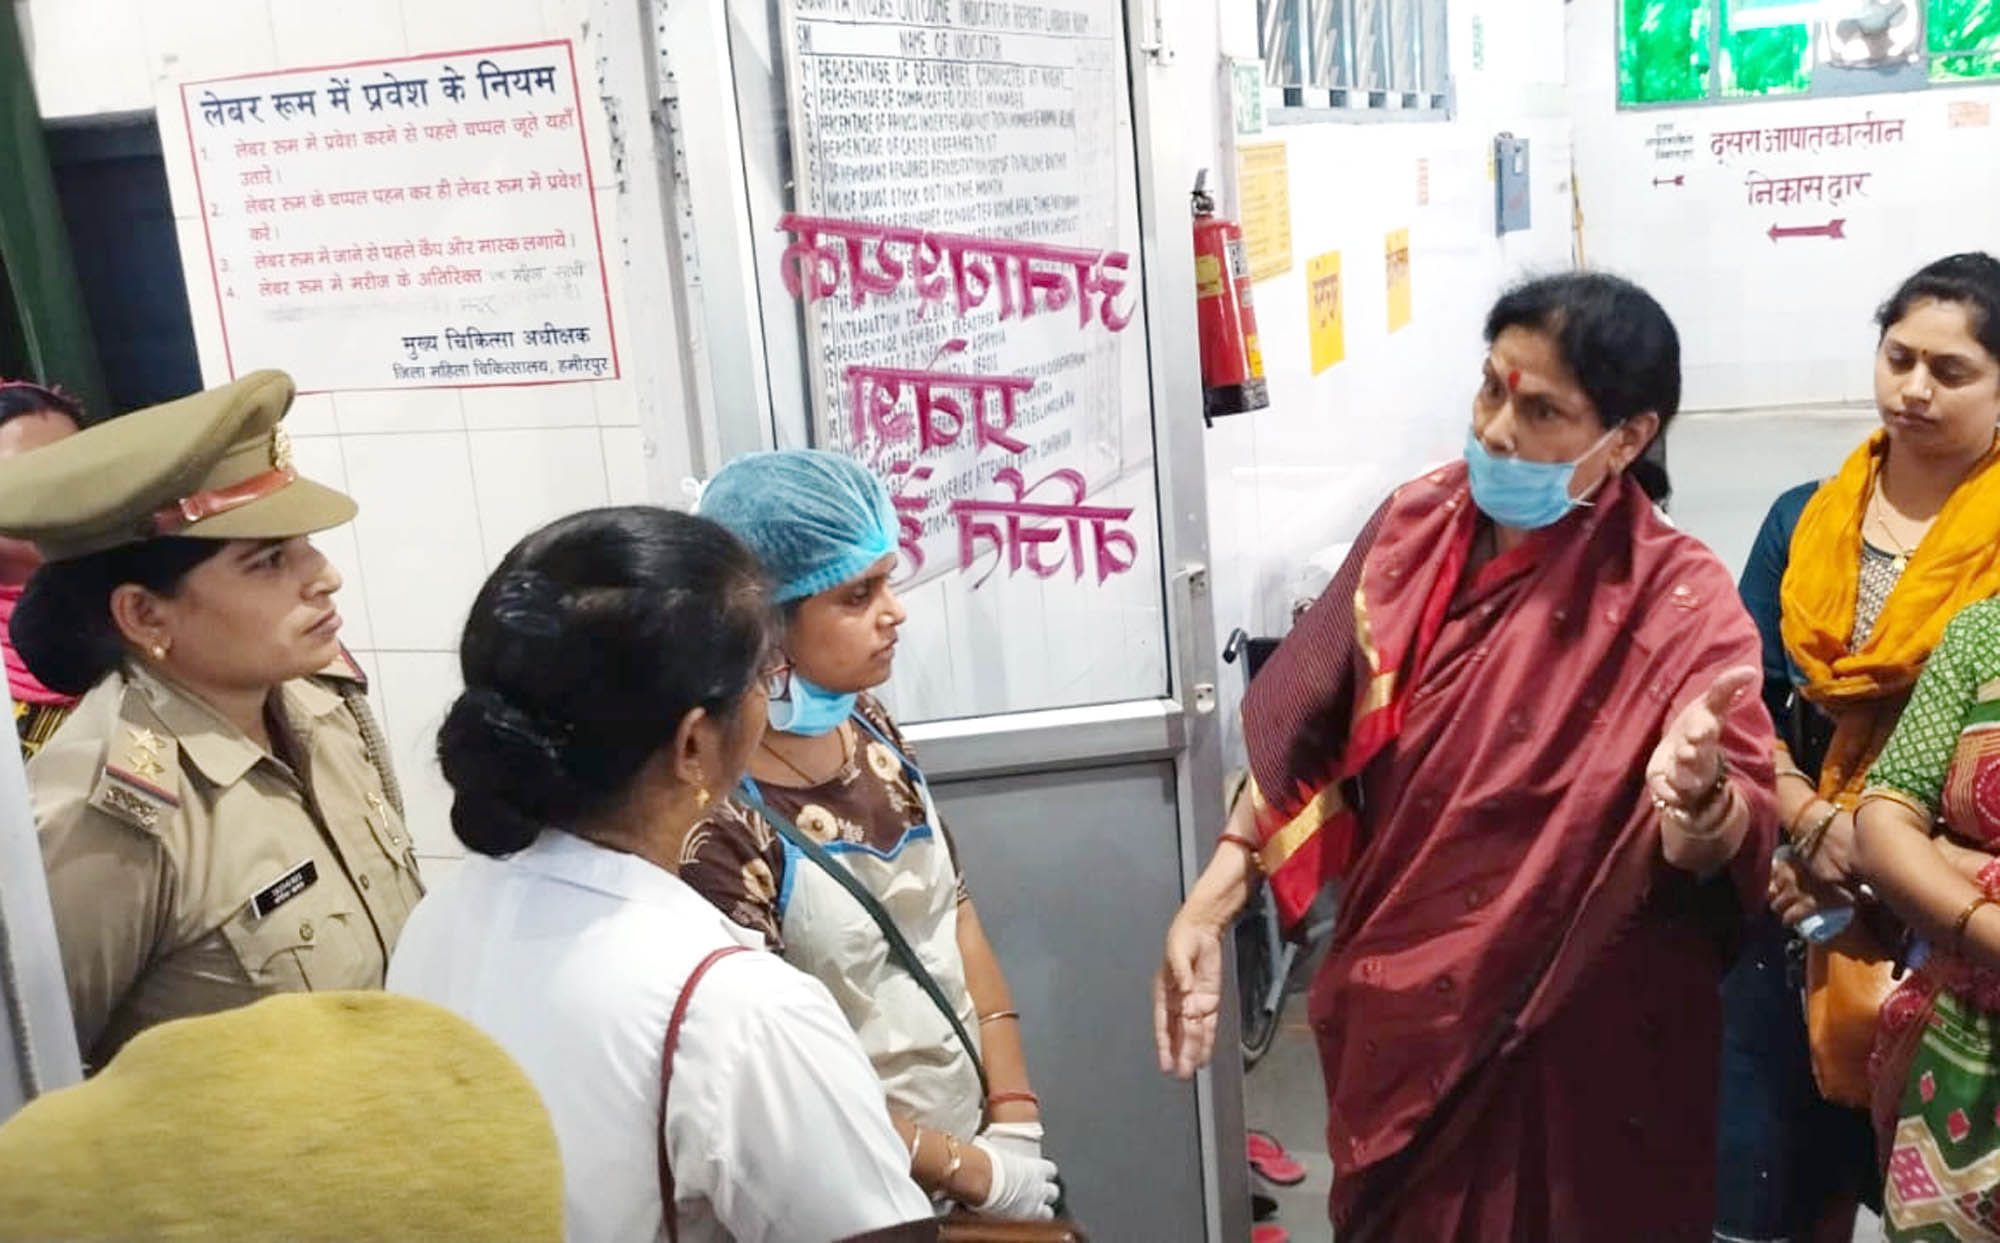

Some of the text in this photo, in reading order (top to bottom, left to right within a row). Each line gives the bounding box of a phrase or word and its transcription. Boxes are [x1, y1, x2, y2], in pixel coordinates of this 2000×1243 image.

[200, 60, 557, 127] लेबर रूम में प्रवेश के नियम
[234, 138, 267, 158] लेबर
[272, 138, 299, 155] रूम
[323, 128, 358, 150] प्रवेश
[363, 123, 398, 145] करने
[403, 121, 418, 143] से
[423, 117, 458, 142] पहले
[463, 117, 506, 138] चप्पल
[511, 111, 539, 139] जूते
[544, 106, 575, 130] यहाँ
[1764, 110, 1905, 155] आपातकालीन
[244, 194, 276, 214] लेबर
[281, 194, 307, 211] रूम
[311, 189, 326, 208] के
[328, 190, 369, 207] चप्पल
[372, 186, 405, 205] पहन
[408, 184, 431, 201] कर
[435, 176, 452, 201] ही
[455, 176, 491, 198] लेबर
[495, 177, 523, 195] रूम
[527, 170, 542, 191] में
[546, 168, 583, 190] प्रवेश
[1744, 169, 1824, 206] निकास
[255, 250, 286, 270] लेबर
[288, 250, 314, 266] रूम
[333, 241, 363, 264] जाने
[366, 240, 379, 262] से
[381, 239, 416, 261] पहले
[448, 235, 475, 256] और
[479, 237, 521, 254] मास्क
[259, 277, 290, 297] लेबर
[296, 278, 323, 294] रूम
[351, 269, 391, 291] मरीज
[395, 267, 412, 288] के
[417, 264, 483, 288] अतिरिक्त
[401, 321, 591, 361] मुख्य चिकित्सा अधीक्षक
[392, 360, 426, 380] जिला
[430, 359, 471, 380] महिला
[558, 353, 609, 378] हमीरपुर
